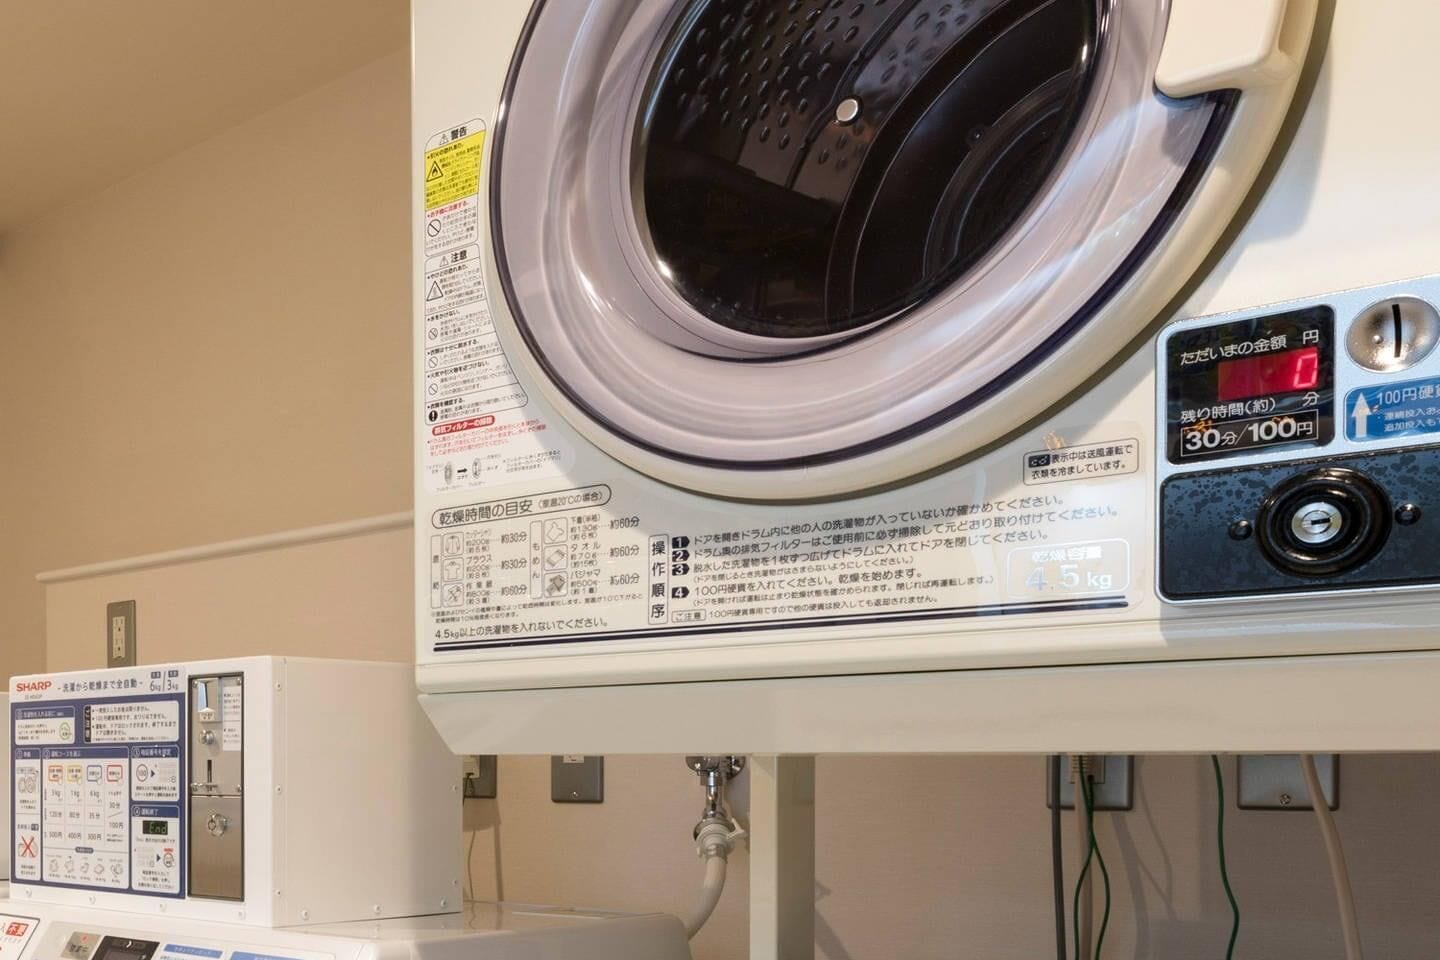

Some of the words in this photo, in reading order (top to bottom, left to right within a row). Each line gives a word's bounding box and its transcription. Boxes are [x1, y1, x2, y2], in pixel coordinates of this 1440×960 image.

[1180, 335, 1287, 366] ただいまの金額
[1302, 329, 1319, 346] 円
[1293, 352, 1318, 389] 0
[1302, 391, 1320, 407] 分
[1185, 420, 1313, 451] 30分/100円
[439, 500, 533, 525] 乾燥時間の目安
[650, 541, 666, 619] 操作順序
[16, 680, 53, 693] SHARP
